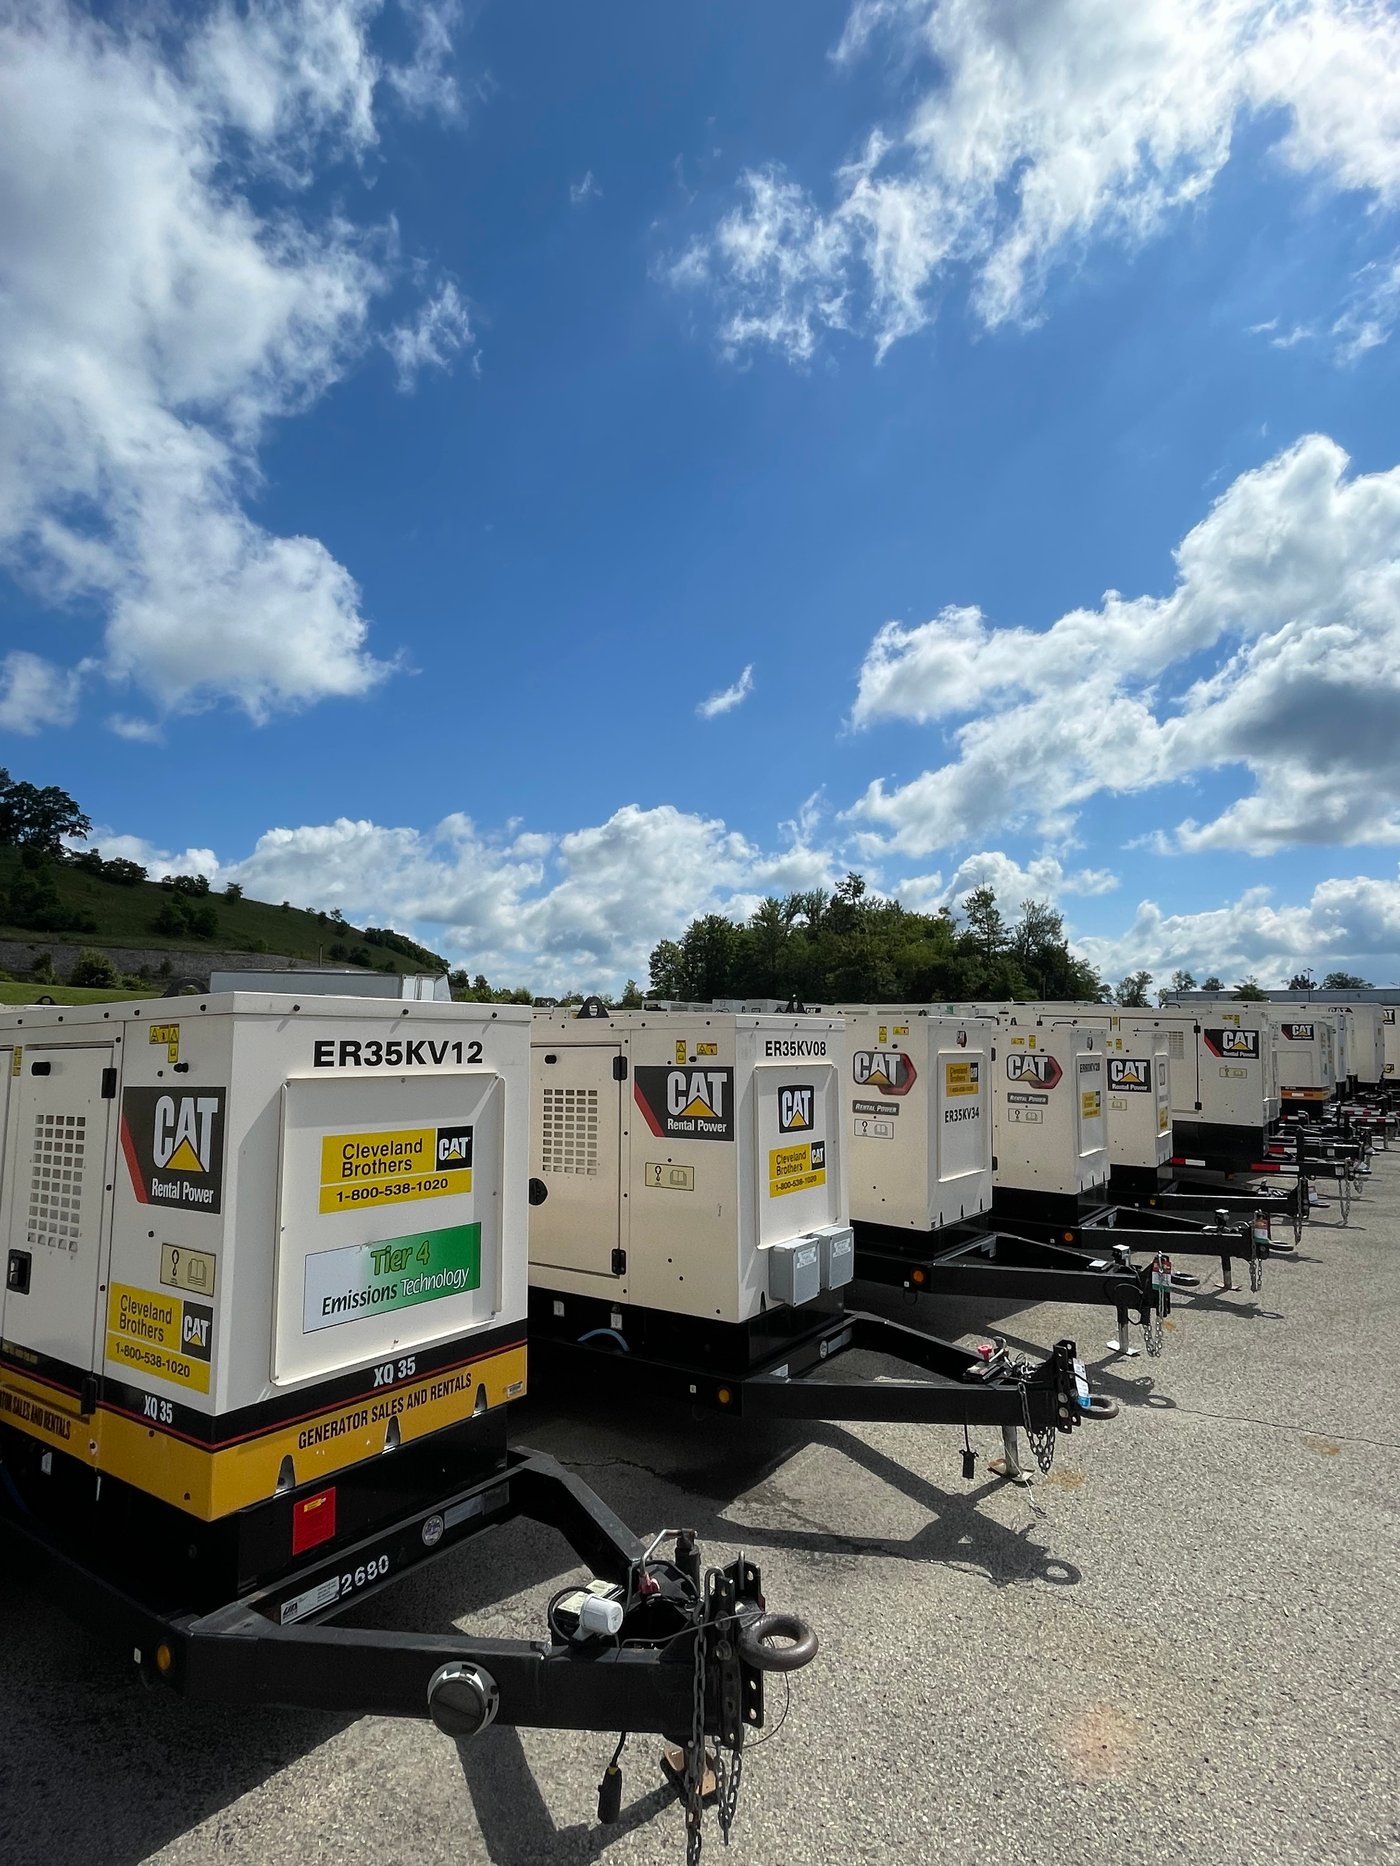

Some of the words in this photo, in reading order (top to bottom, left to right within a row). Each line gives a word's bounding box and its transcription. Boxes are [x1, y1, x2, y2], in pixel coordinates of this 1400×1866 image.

[1222, 1031, 1256, 1051] CAT
[1292, 1025, 1312, 1036] CAT
[313, 1040, 483, 1067] ER35KV12
[765, 1041, 826, 1057] ER35KV08
[854, 1051, 901, 1085] CAT
[1007, 1056, 1048, 1081] CAT
[1111, 1061, 1147, 1083] CAT
[667, 1071, 728, 1118] CAT
[781, 1090, 811, 1128] CAT
[944, 1106, 980, 1124] ER35KV34
[153, 1095, 219, 1173] CAT
[667, 1118, 695, 1131] Rental
[697, 1119, 727, 1133] Power
[342, 1138, 423, 1160] Cleveland
[438, 1137, 469, 1161] CAT
[776, 1150, 807, 1166] Cleveland
[811, 1147, 824, 1164] CAT
[341, 1158, 412, 1178] Brothers
[776, 1162, 803, 1176] Brothers
[151, 1177, 181, 1200] Rental
[182, 1181, 214, 1204] Power
[336, 1178, 448, 1202] 1-800-538-1020
[370, 1245, 413, 1276] Tier
[416, 1240, 430, 1265] 4
[321, 1284, 398, 1316] Emissions
[400, 1267, 470, 1297] Technology
[120, 1294, 173, 1325] Cleveland
[119, 1312, 164, 1342] Brothers
[183, 1315, 210, 1348] CAT
[115, 1341, 190, 1378] 1-800-538-1020
[373, 1363, 394, 1388] XQ
[398, 1356, 416, 1379] 35
[143, 1394, 158, 1421] XQ
[159, 1401, 173, 1424] 35
[298, 1410, 368, 1450] GENERATOR
[371, 1396, 404, 1422] SALES
[406, 1388, 427, 1410] AND
[430, 1372, 472, 1401] RENTALS
